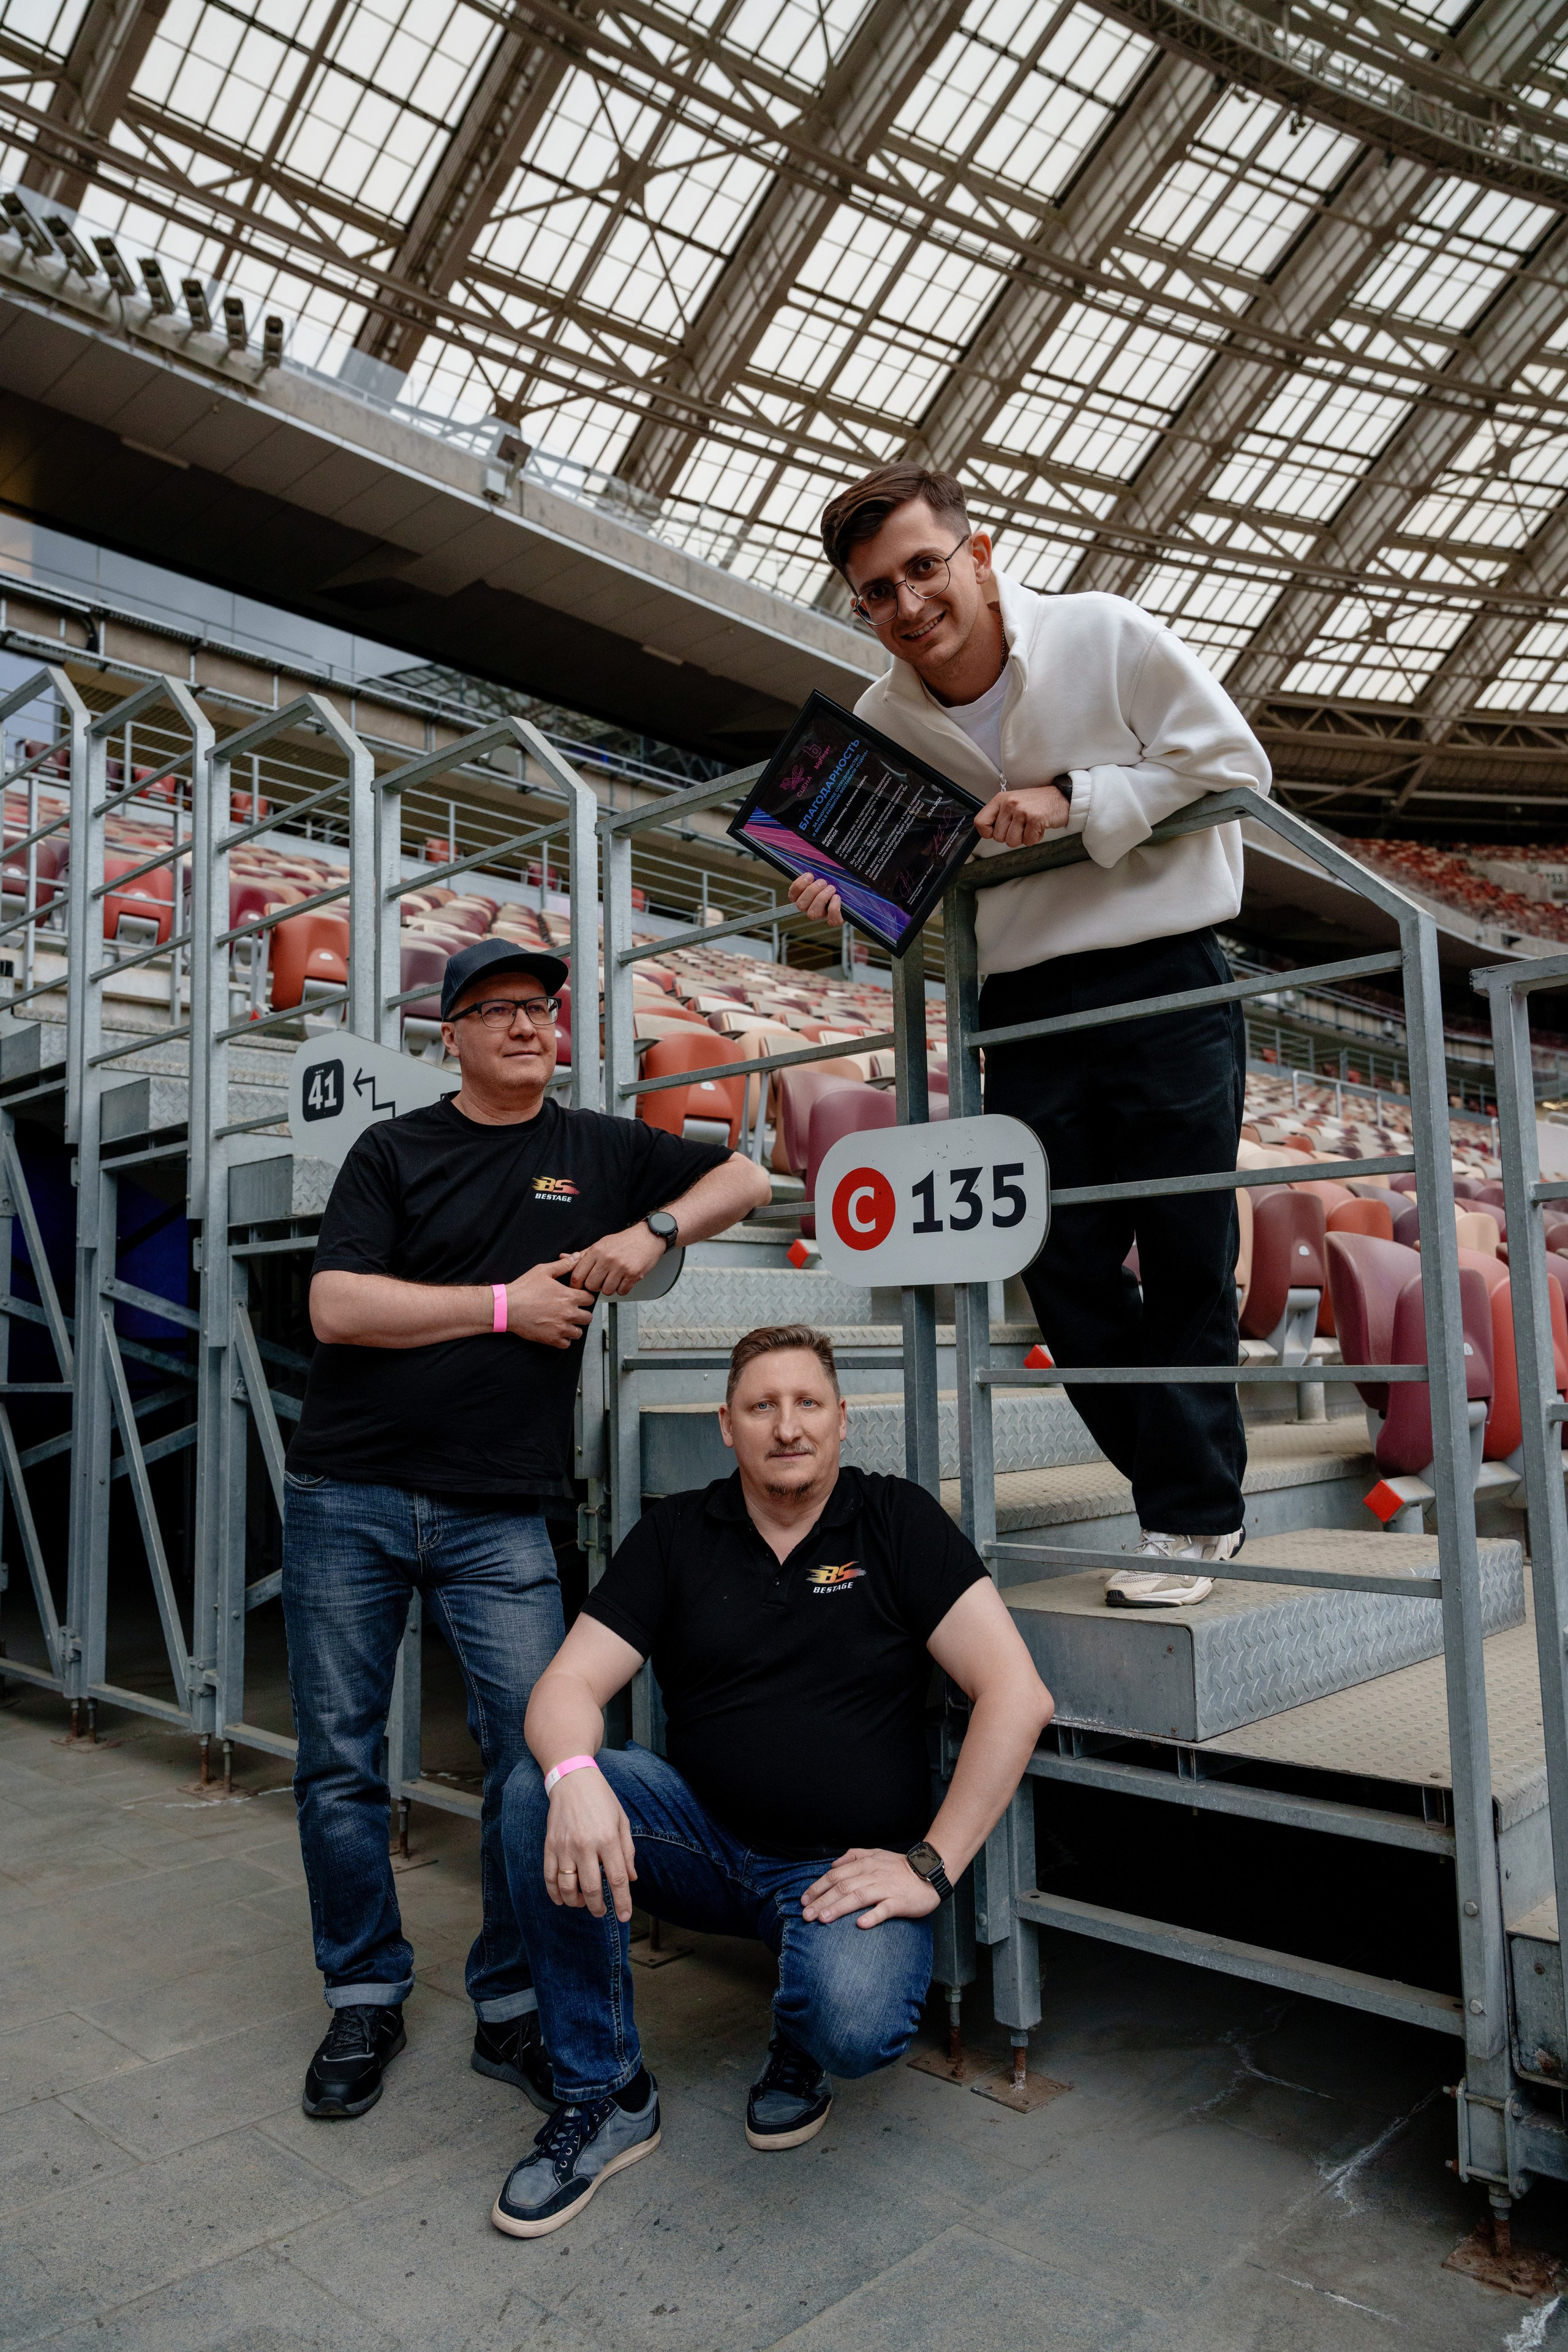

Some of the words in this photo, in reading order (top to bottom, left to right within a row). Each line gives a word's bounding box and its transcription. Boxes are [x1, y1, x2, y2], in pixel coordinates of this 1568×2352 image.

[796, 775, 812, 797] СЦЕНА
[798, 737, 860, 831] БЛАГОДАРНОСТЬ
[813, 744, 831, 769] bigfinger
[814, 818, 826, 833] ВКЛАД
[826, 793, 841, 815] РАЗВИТИЕ
[839, 768, 856, 794] ФЕСТИВАЛЯ
[855, 749, 869, 768] «СЦЕНА»
[816, 791, 836, 822] МНОГОЛЕТНЕЕ
[834, 754, 860, 792] СОТРУДНИЧЕСТВО
[821, 826, 834, 845] Виталию
[832, 806, 848, 827] Новикову,
[845, 788, 858, 807] Алексею
[856, 774, 868, 789] Серых,
[835, 831, 851, 854] Благодарим
[858, 793, 876, 819] партнёрство,
[874, 771, 890, 793] поддержку
[841, 829, 858, 853] неизменную
[857, 800, 876, 829] вовлечённость
[876, 776, 892, 797] фестиваль
[884, 824, 899, 845] фестиваля
[903, 805, 911, 816] таких
[910, 785, 924, 805] надёжных
[926, 796, 942, 817] 25.04.2025
[825, 829, 838, 847] BESTAGE
[846, 830, 862, 854] протяжении
[861, 815, 872, 830] многих
[853, 847, 862, 858] были
[878, 802, 891, 821] ключевые
[891, 783, 903, 802] моменты
[854, 851, 865, 867] «Сцены»
[883, 805, 895, 821] проекта
[894, 791, 903, 805] просто
[861, 836, 880, 864] существовало.
[869, 863, 880, 878] союзах.
[878, 851, 887, 863] Пусть
[886, 834, 897, 852] впереди
[895, 823, 905, 835] будет
[908, 799, 921, 815] больше
[872, 849, 894, 881] вдохновляющих
[892, 832, 905, 849] событий
[905, 815, 915, 829] общих
[914, 801, 924, 816] побед!
[308, 1069, 337, 1110] 41
[532, 1175, 580, 1194] BS
[535, 1193, 572, 1202] BESTAGE
[848, 1186, 876, 1233] C
[912, 1163, 1027, 1234] 135
[806, 1561, 867, 1584] BS
[813, 1581, 853, 1593] BESTAGE
